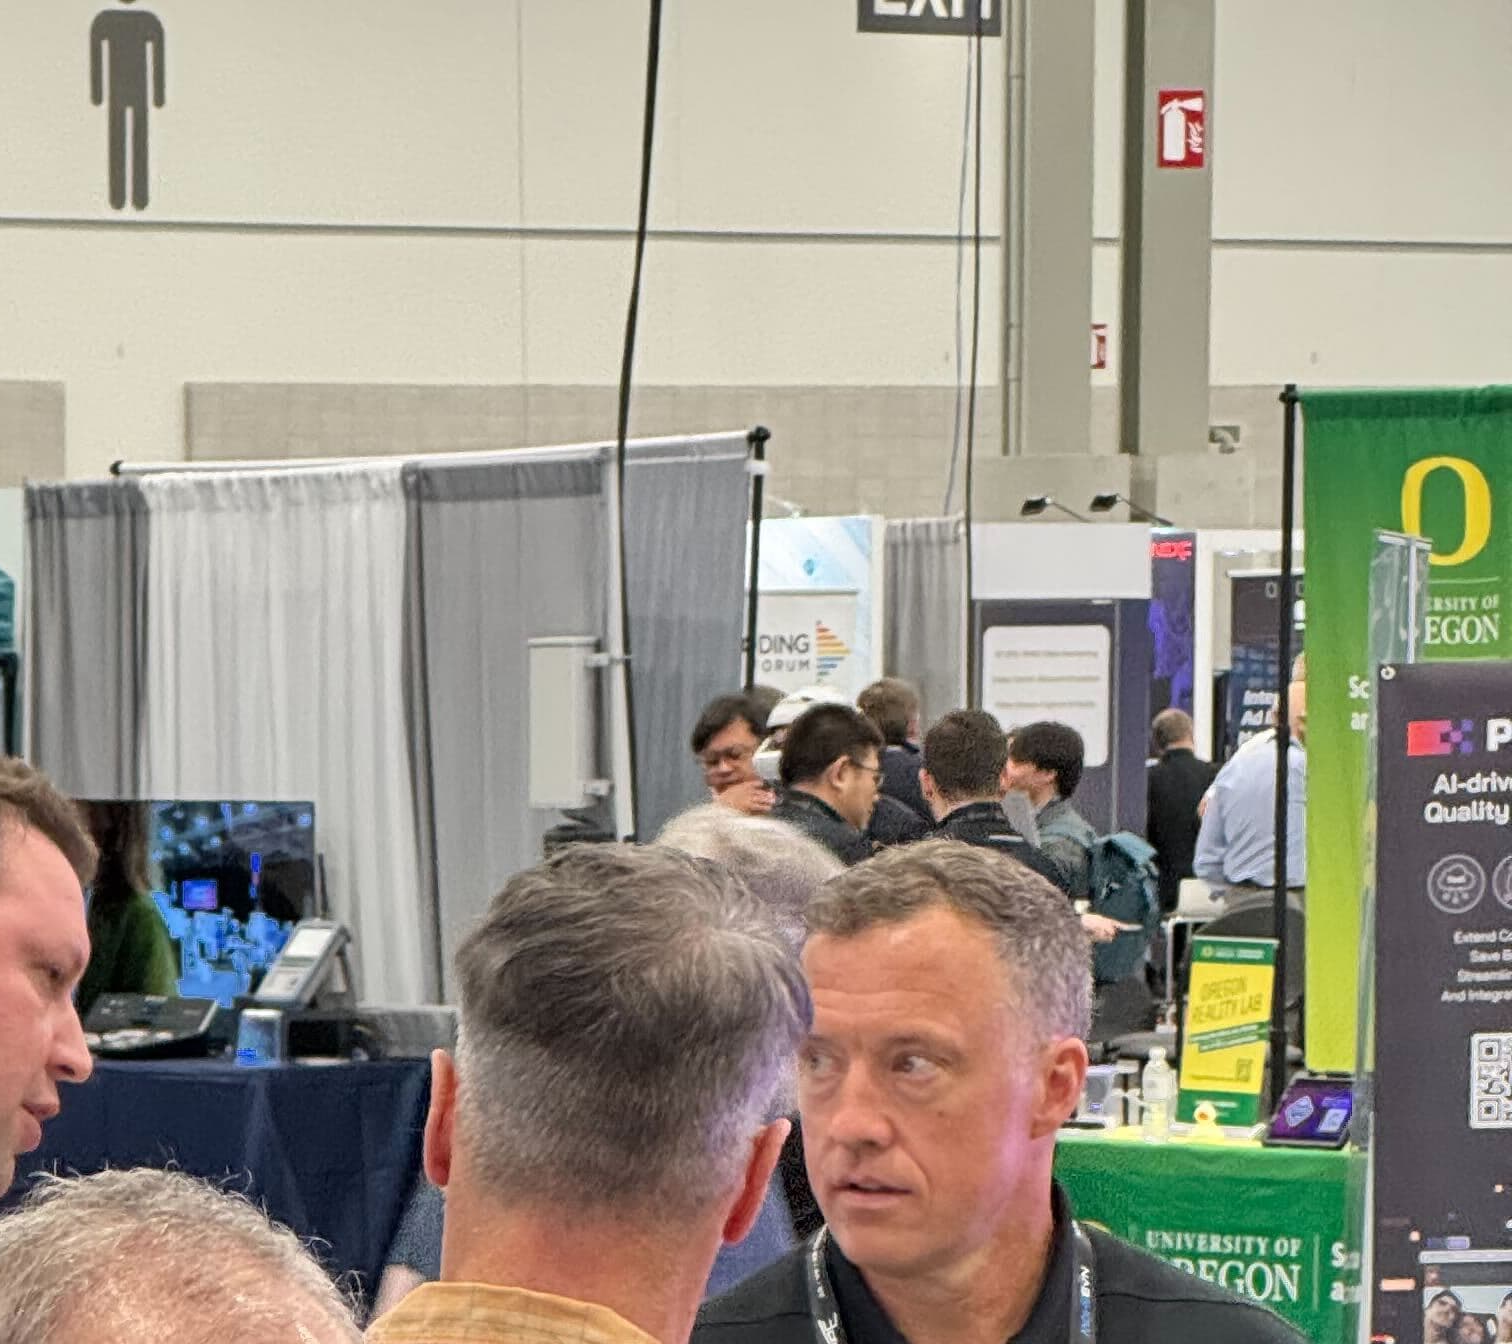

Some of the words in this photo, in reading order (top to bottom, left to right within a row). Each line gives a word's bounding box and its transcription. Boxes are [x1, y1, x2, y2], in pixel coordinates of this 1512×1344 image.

[1426, 595, 1478, 611] ERSITY
[1424, 613, 1500, 644] EGON
[756, 634, 809, 655] DING
[760, 659, 810, 672] ORUM
[1424, 799, 1510, 825] Quality
[1146, 1230, 1270, 1257] UNIVERSITY
[1274, 1238, 1302, 1257] OF
